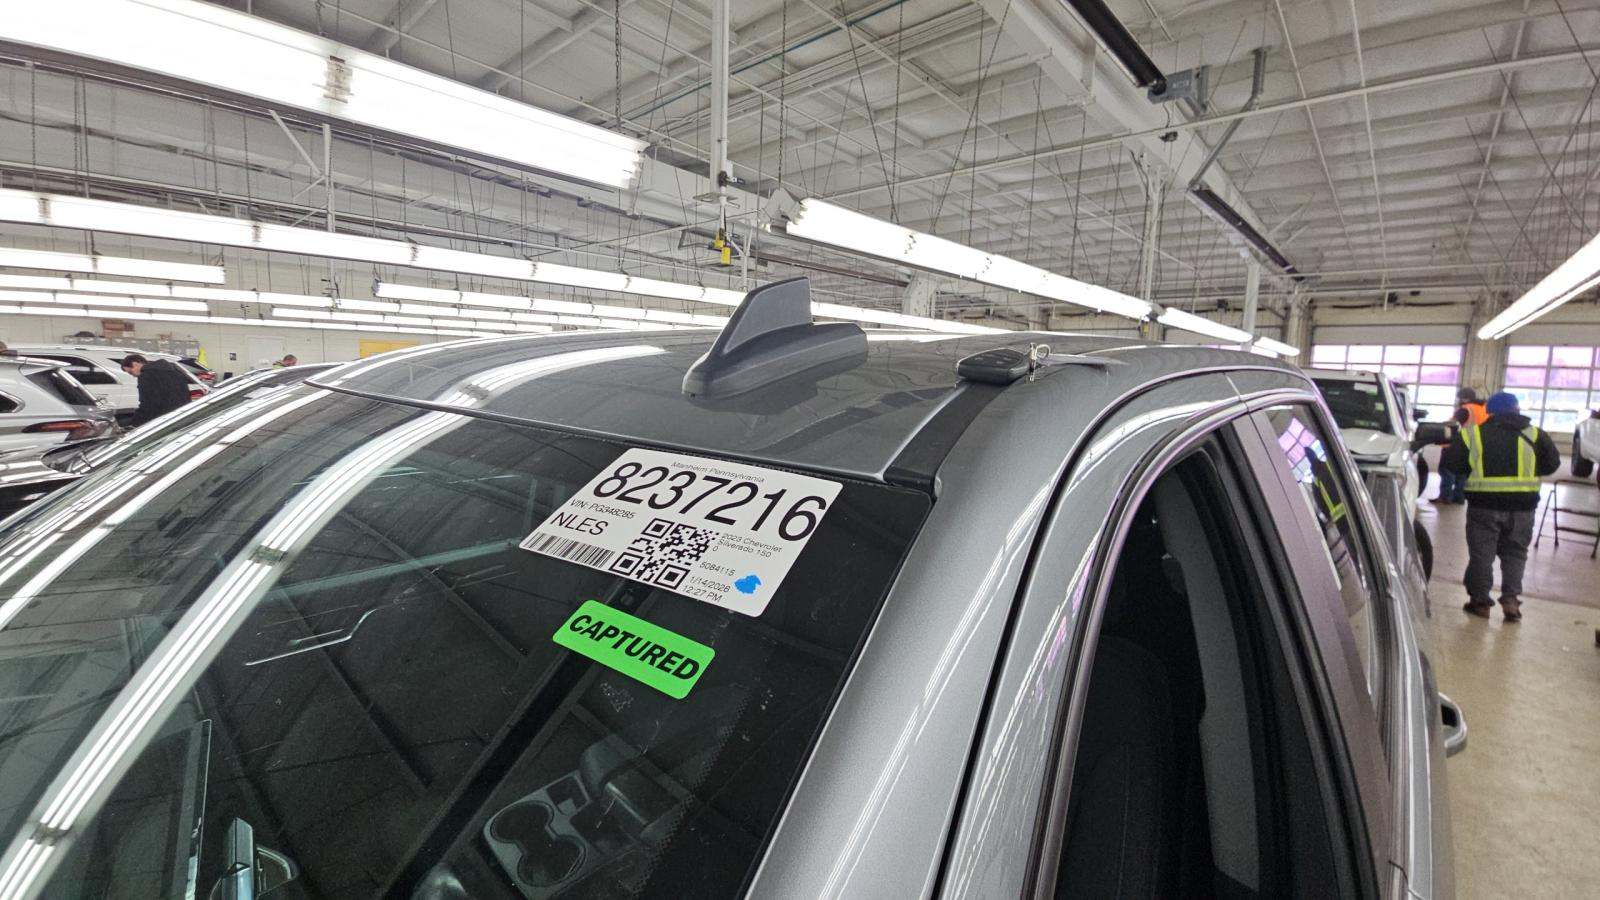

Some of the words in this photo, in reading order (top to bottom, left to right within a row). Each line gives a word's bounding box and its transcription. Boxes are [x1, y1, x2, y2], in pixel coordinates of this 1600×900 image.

[589, 503, 636, 519] PG348285
[593, 462, 827, 541] 8237216
[550, 511, 608, 535] NLES
[717, 539, 754, 553] Silverado
[756, 549, 772, 558] 150
[722, 533, 743, 543] 2023
[743, 537, 782, 553] Chevrolet
[682, 585, 707, 597] 12:27
[706, 590, 723, 601] PM
[689, 576, 731, 593] 1/14/2026
[569, 614, 700, 680] CAPTURED
